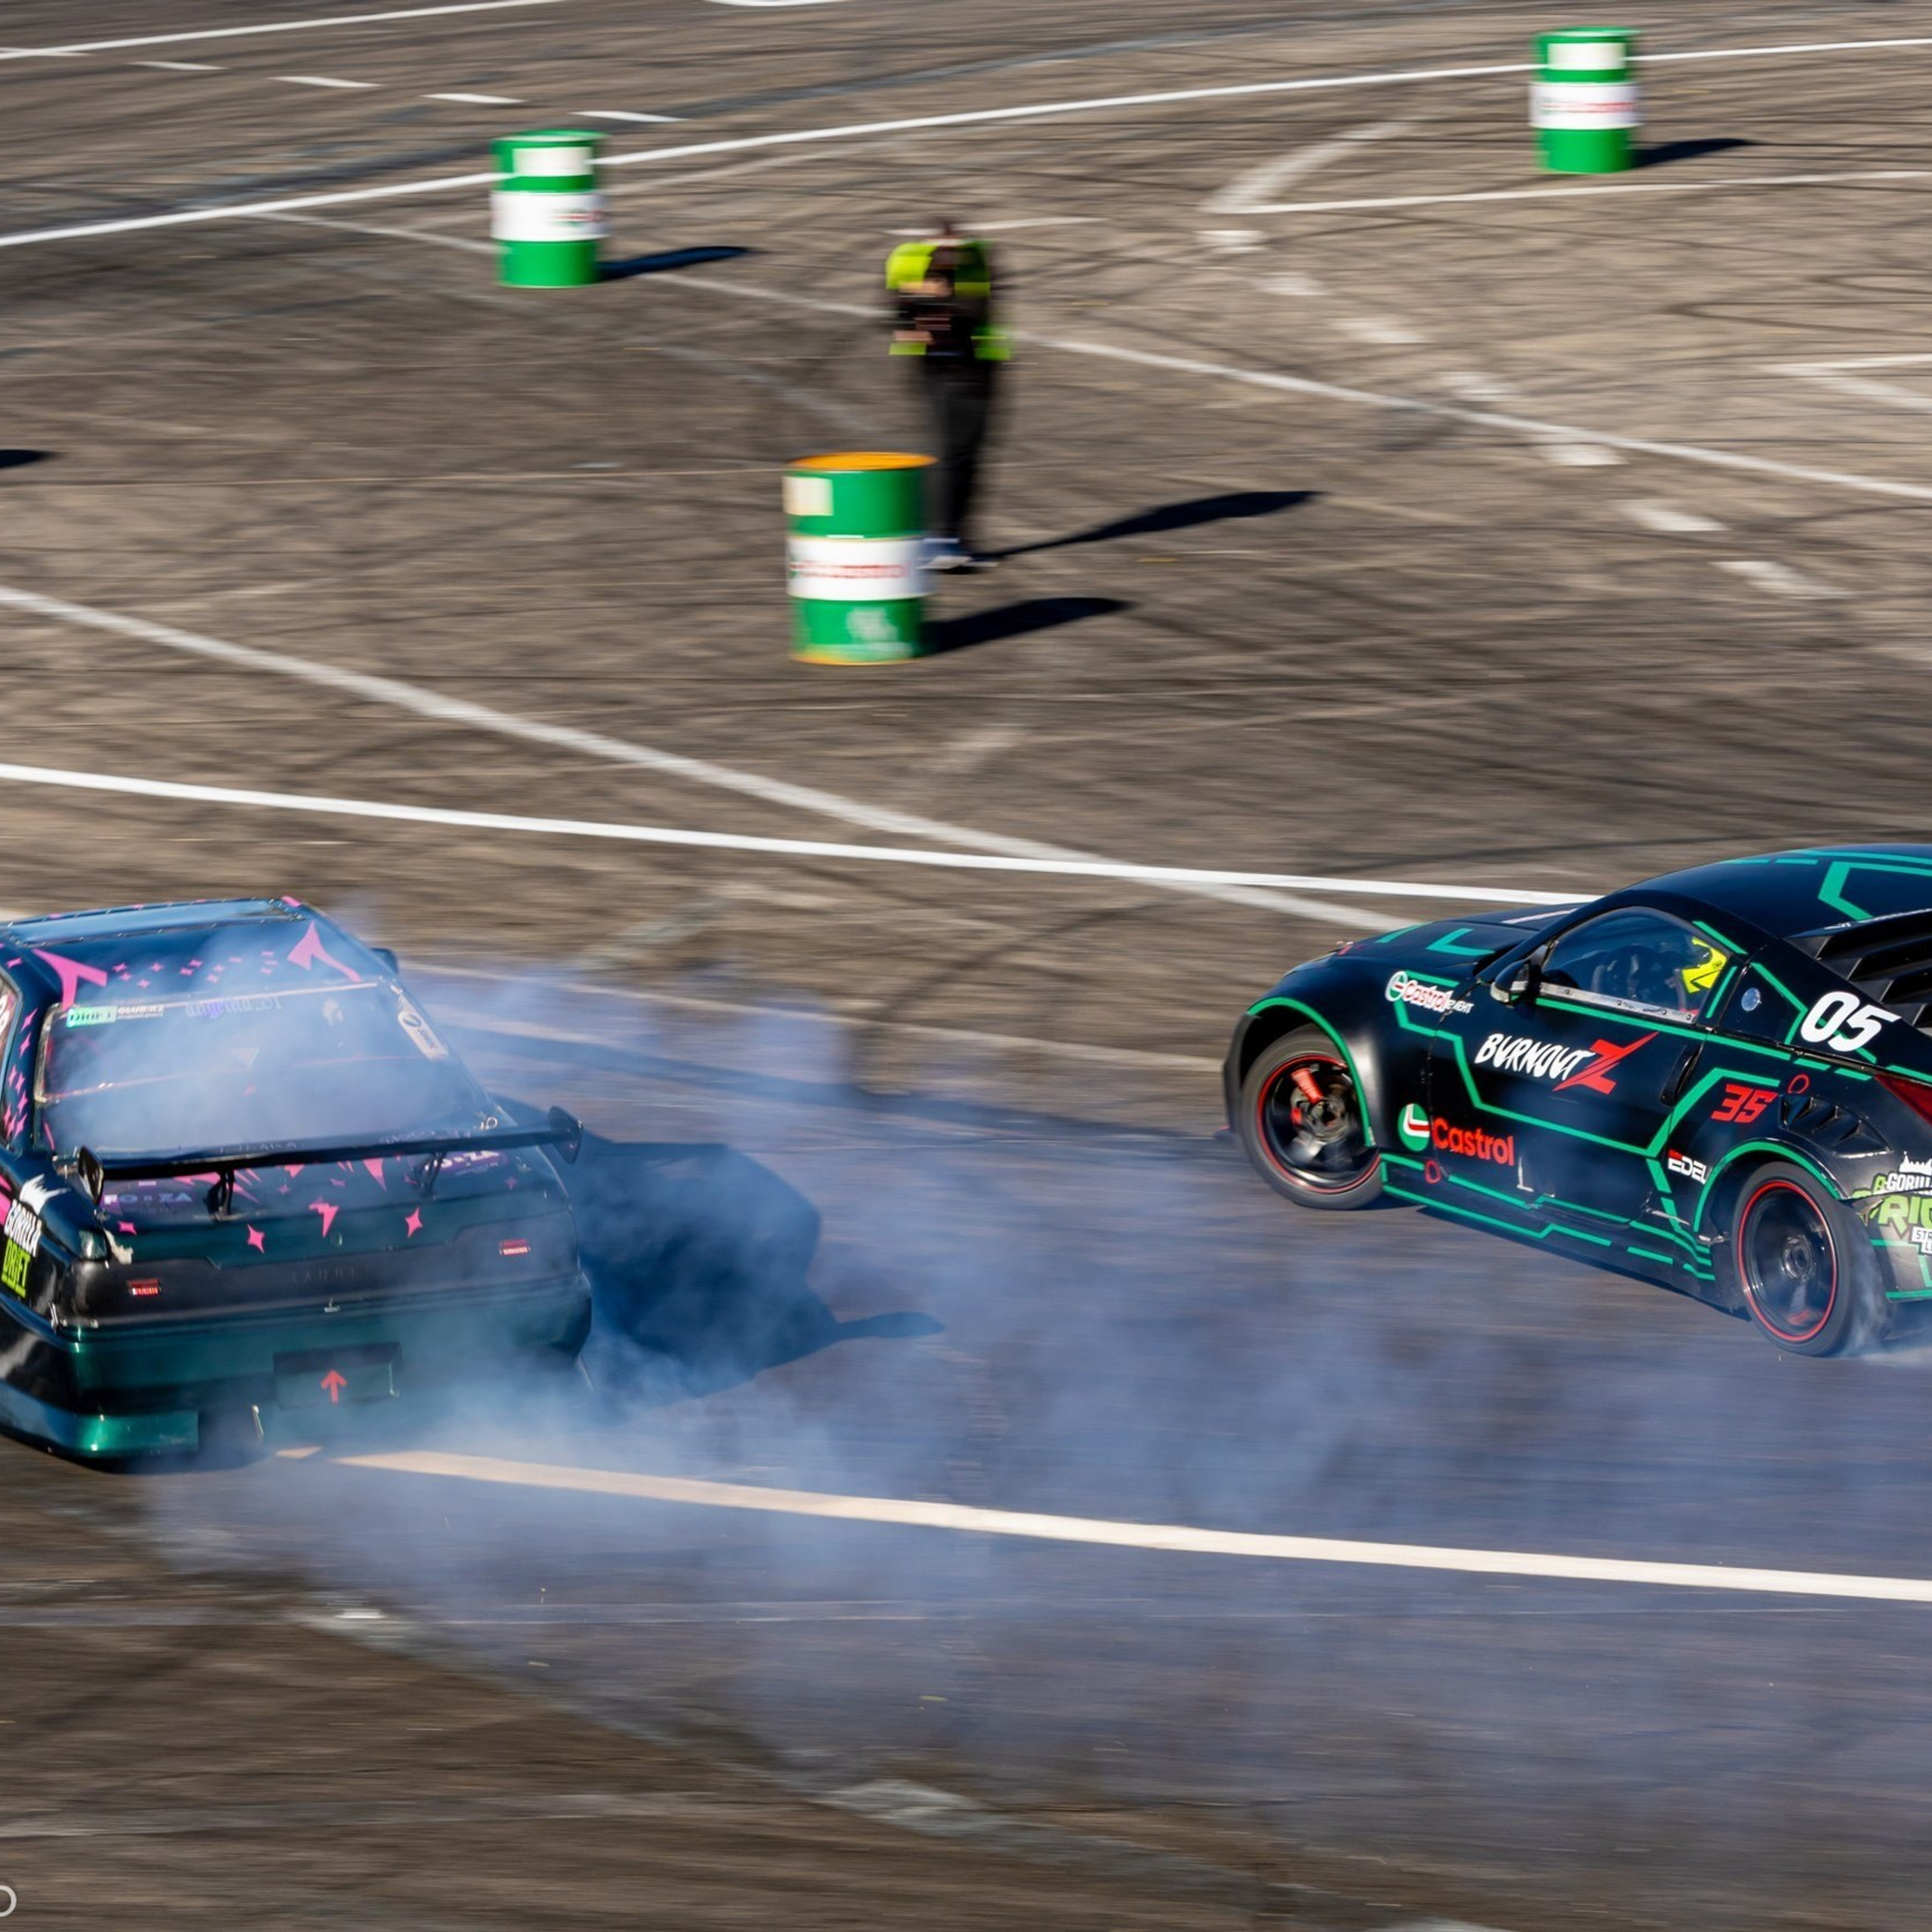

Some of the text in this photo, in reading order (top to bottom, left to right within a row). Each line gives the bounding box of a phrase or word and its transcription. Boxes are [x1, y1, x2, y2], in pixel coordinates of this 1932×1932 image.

[1801, 991, 1902, 1052] 05
[1474, 1033, 1596, 1081] BURNOUT
[1711, 1084, 1779, 1123] 35
[1432, 1117, 1514, 1166] Castrol
